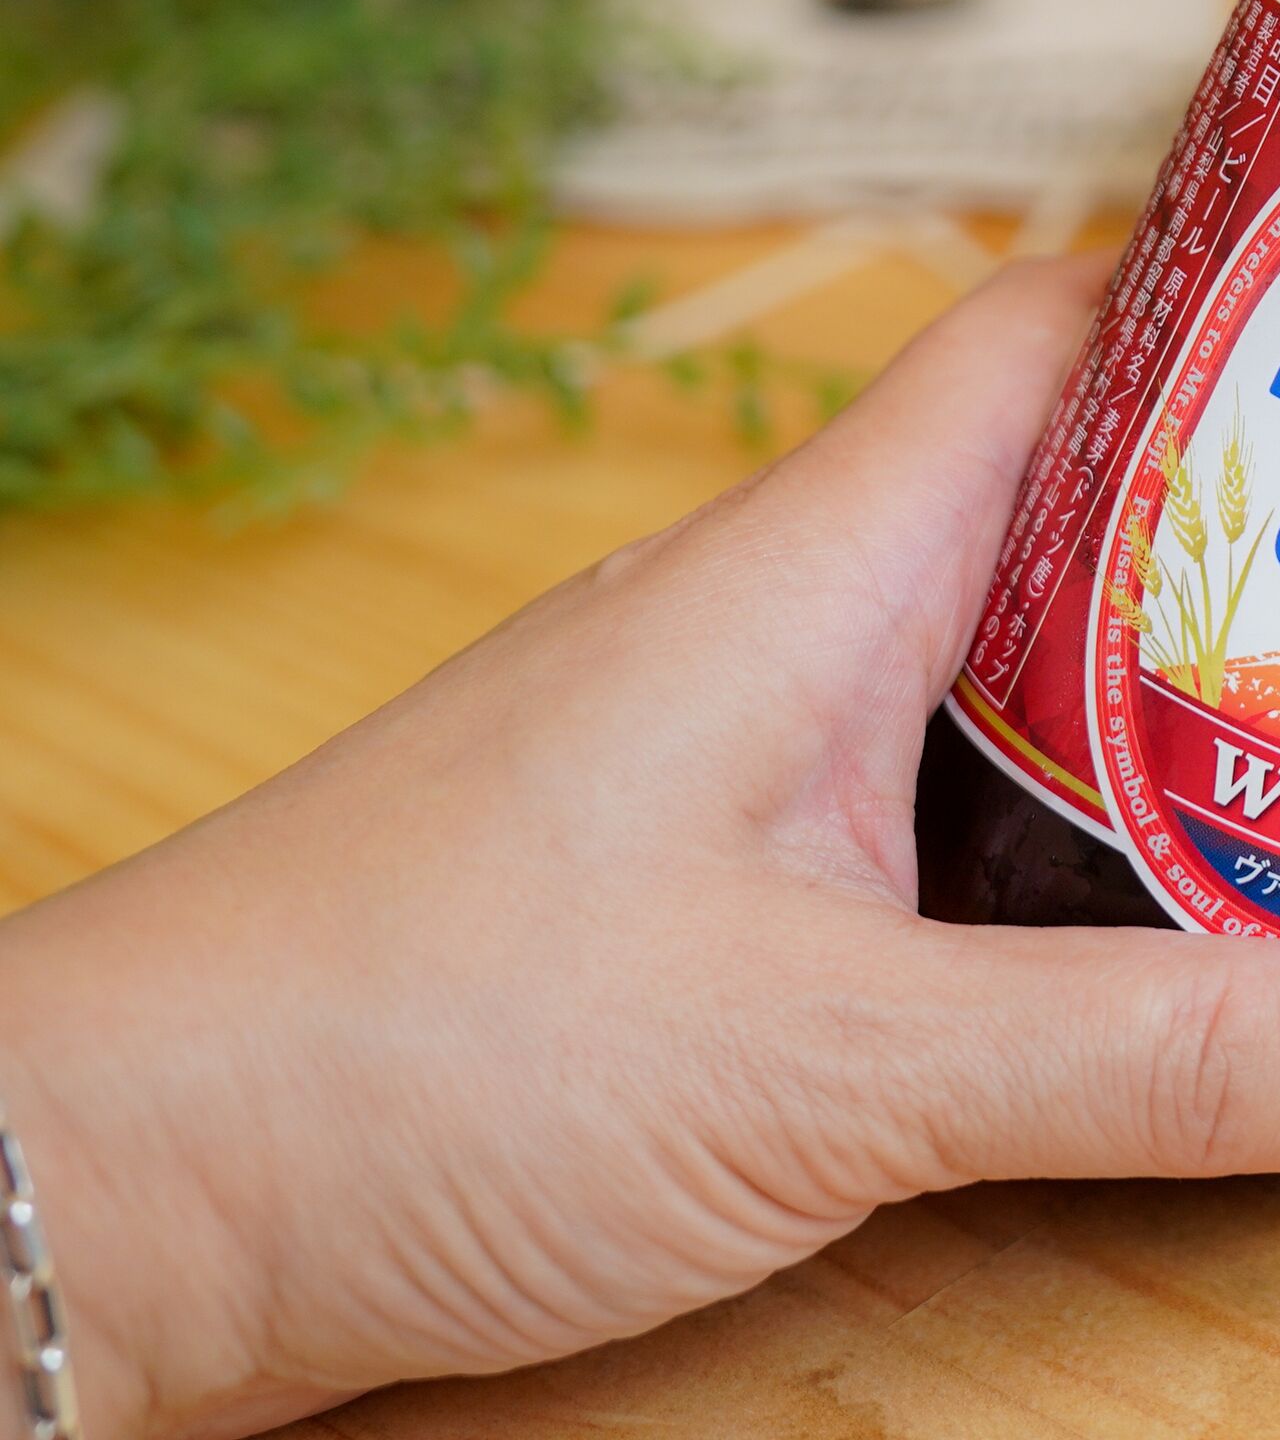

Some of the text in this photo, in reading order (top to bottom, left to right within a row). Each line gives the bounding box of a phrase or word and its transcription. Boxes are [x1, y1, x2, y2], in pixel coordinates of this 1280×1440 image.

[1216, 242, 1270, 322] refers
[1199, 329, 1221, 359] to
[1106, 656, 1128, 705] the
[1105, 716, 1159, 828] symbol
[1147, 833, 1172, 859] &
[1166, 864, 1224, 921] soul
